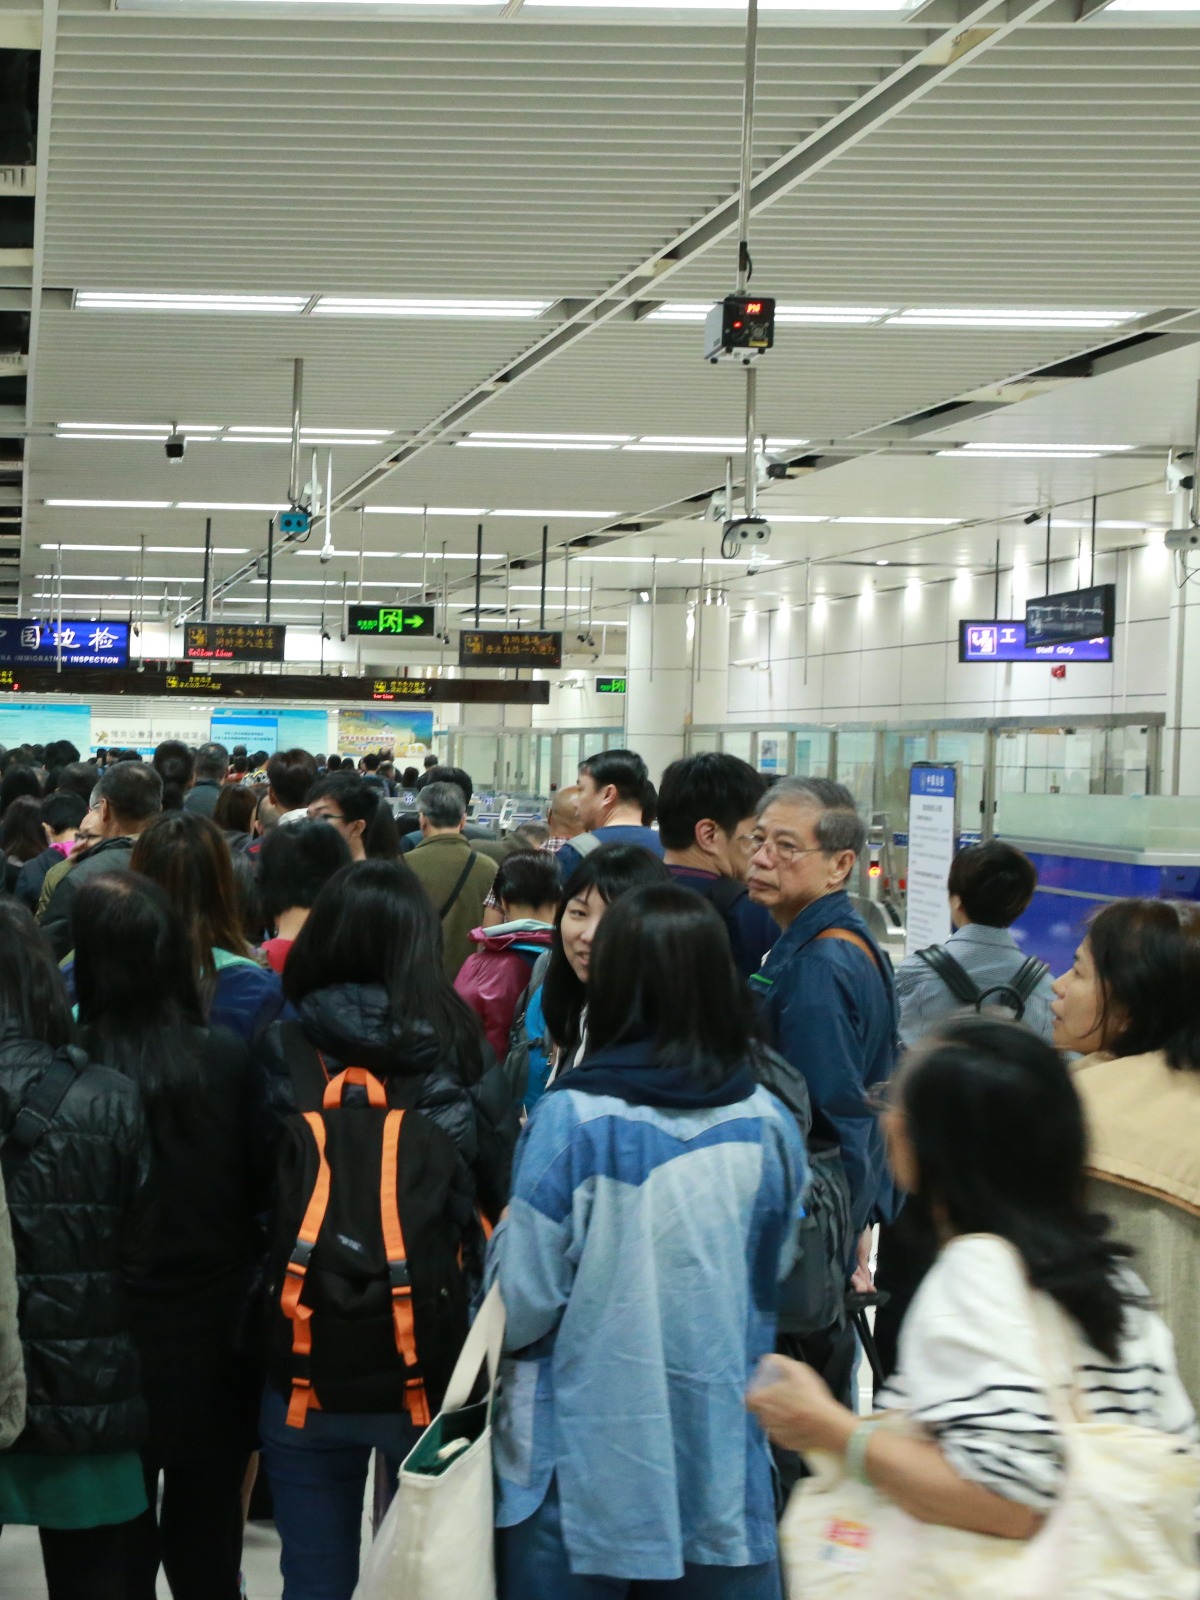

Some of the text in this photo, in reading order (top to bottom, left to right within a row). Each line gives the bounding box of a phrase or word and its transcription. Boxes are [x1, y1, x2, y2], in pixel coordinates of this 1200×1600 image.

[1035, 645, 1075, 655] Staff Only
[70, 655, 119, 664] INSPECTION
